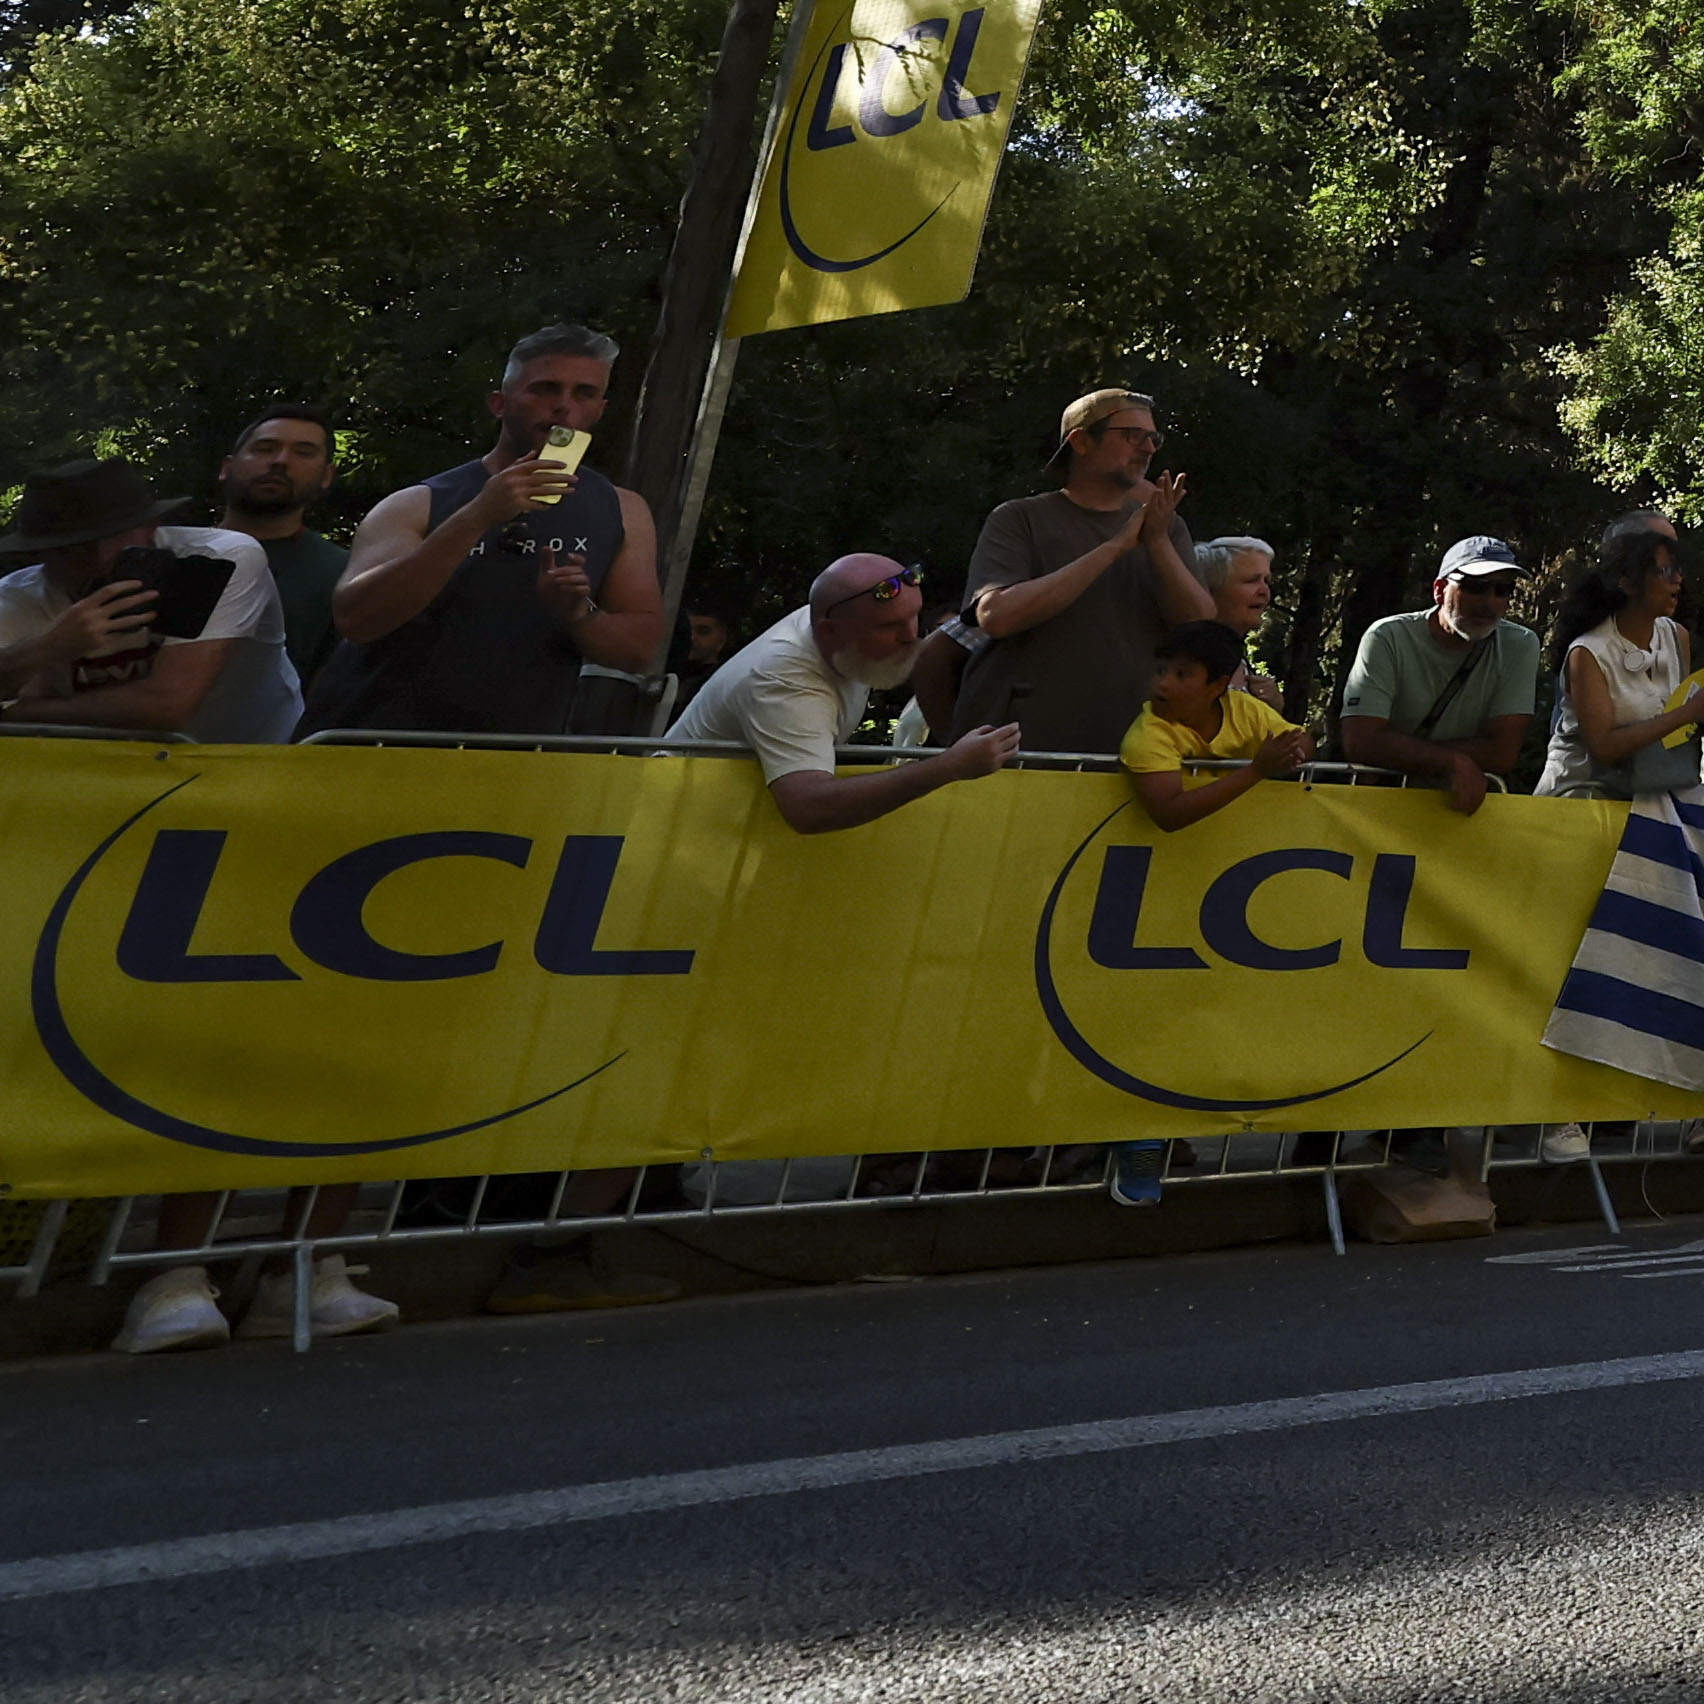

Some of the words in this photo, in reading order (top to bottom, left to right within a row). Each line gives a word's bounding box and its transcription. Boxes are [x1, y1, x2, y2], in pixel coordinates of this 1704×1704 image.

[807, 8, 1000, 151] LCL
[469, 537, 587, 556] HROX
[116, 829, 696, 983] LCL
[1087, 845, 1470, 970] LCL
